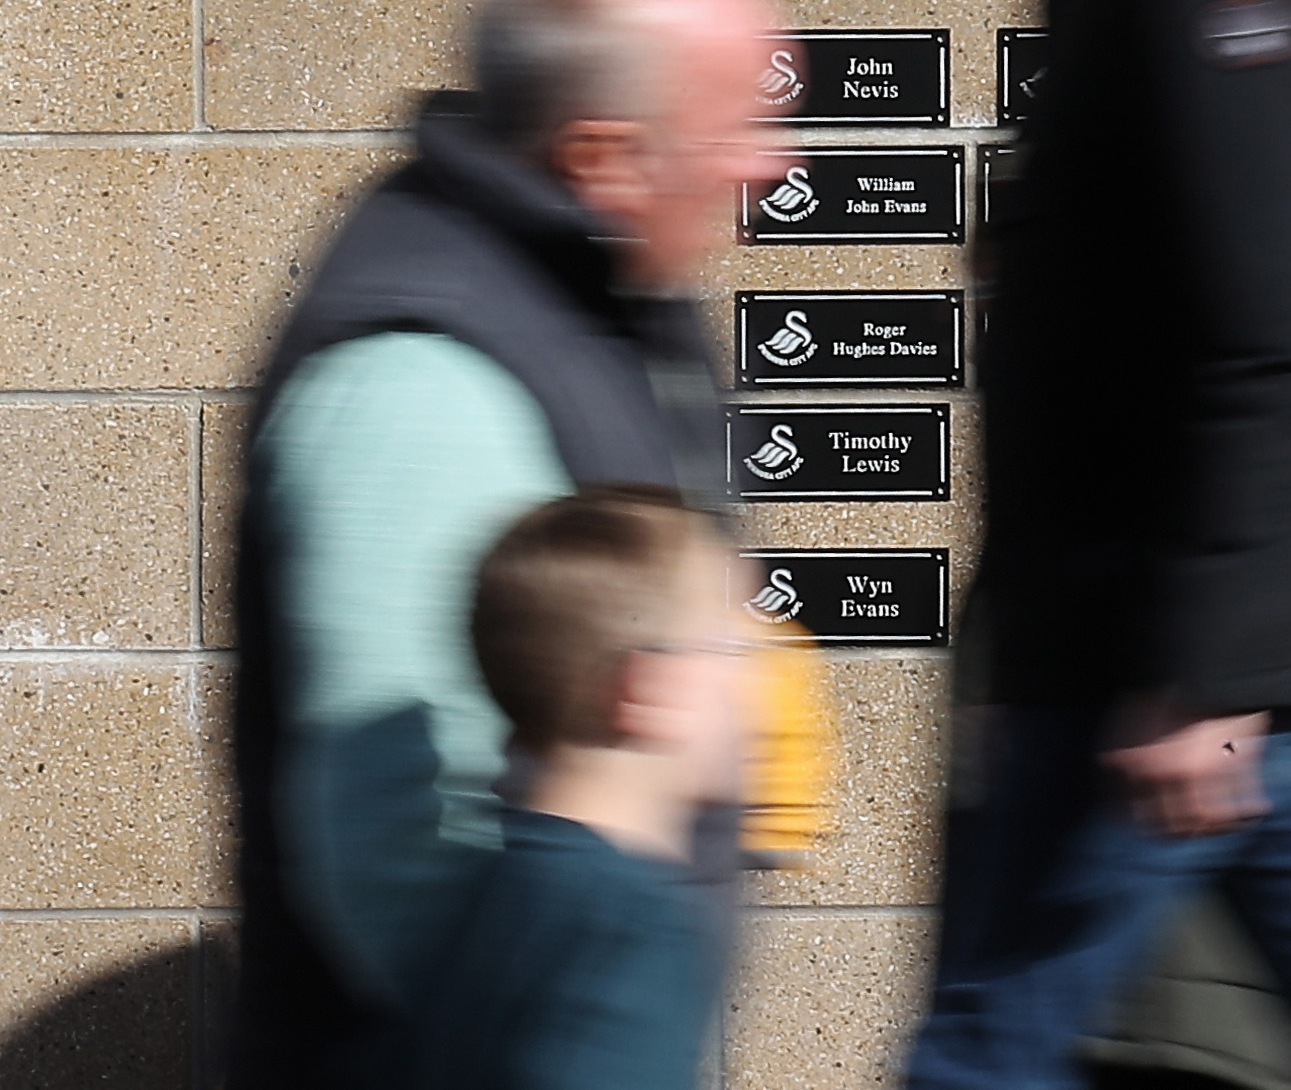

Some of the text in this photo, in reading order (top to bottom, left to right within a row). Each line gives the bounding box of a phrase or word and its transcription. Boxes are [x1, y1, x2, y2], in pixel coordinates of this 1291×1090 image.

[846, 57, 893, 76] John
[843, 80, 899, 99] Nevis
[856, 177, 915, 192] William
[845, 199, 927, 214] John Evans
[863, 322, 907, 339] Roger
[828, 431, 912, 454] Timothy
[842, 454, 900, 473] Lewis
[846, 575, 893, 598] Wyn
[841, 599, 900, 618] Evans
